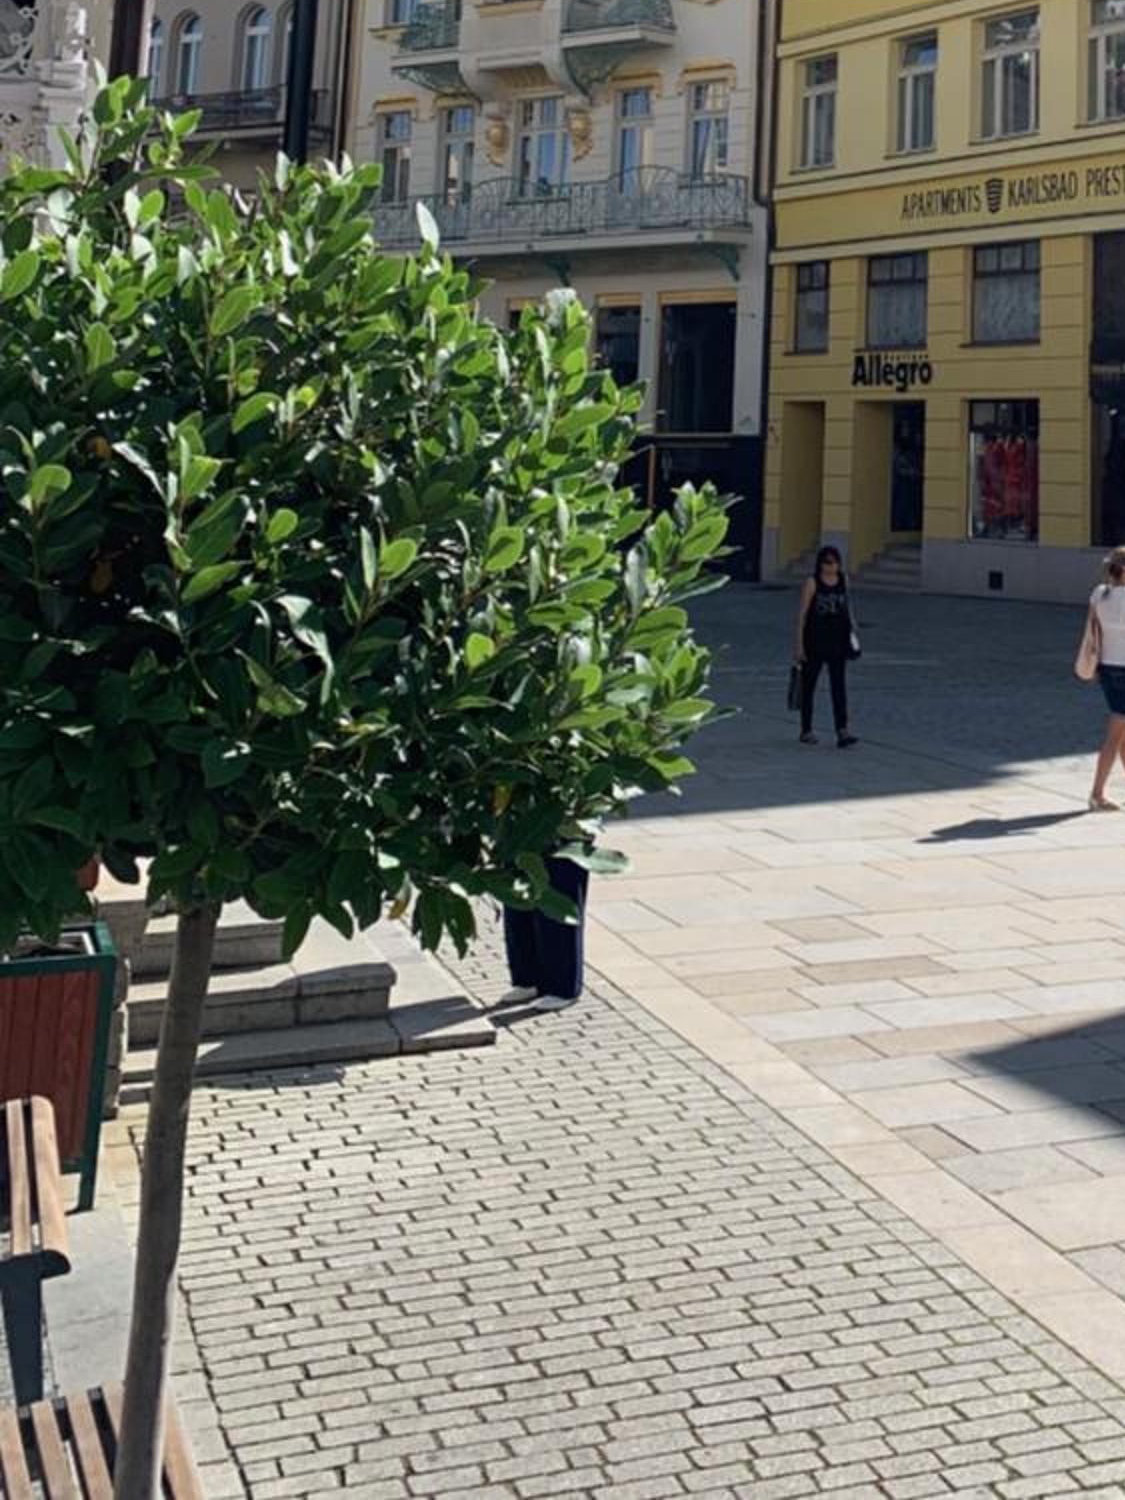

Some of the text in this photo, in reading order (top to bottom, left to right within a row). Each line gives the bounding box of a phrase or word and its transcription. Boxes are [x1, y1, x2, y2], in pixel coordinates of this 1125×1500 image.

[902, 184, 981, 219] APARTMENTS
[1008, 171, 1079, 207] KARLSBAD
[851, 355, 932, 392] Allegro
